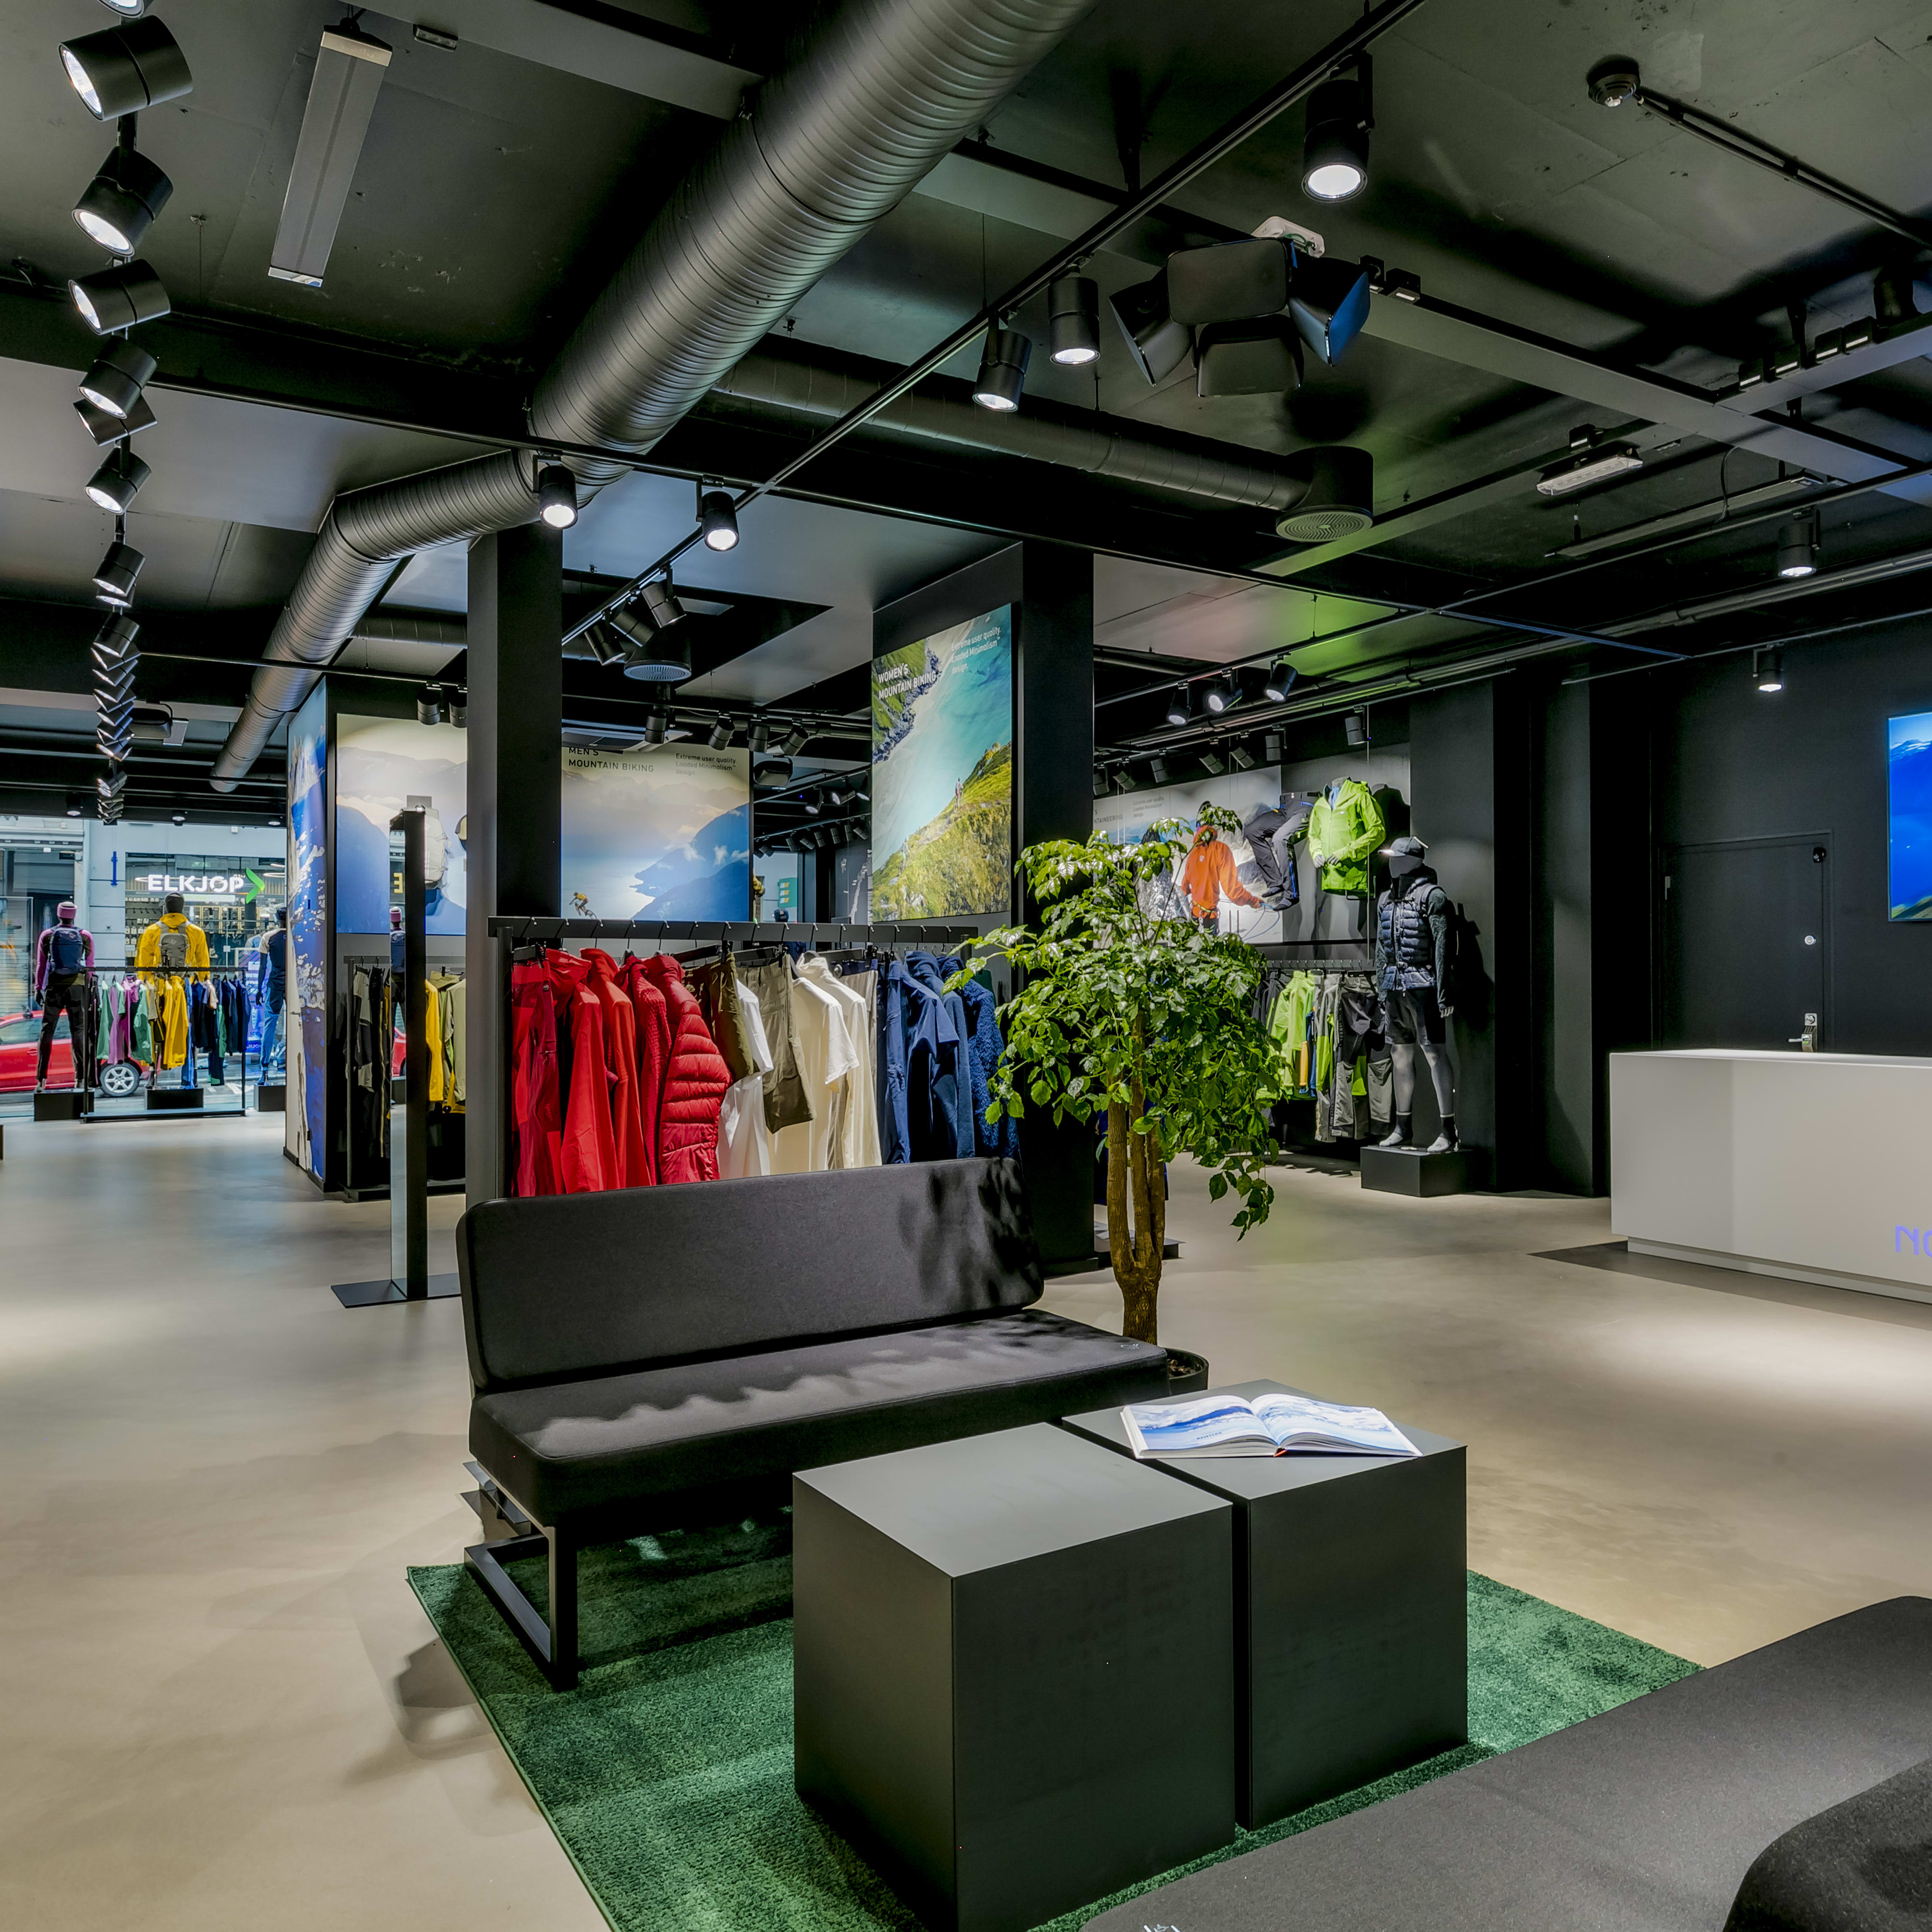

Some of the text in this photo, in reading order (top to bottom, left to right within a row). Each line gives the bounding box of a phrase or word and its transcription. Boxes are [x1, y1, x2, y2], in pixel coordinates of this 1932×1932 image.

[951, 626, 1001, 652] Extreme user quality.
[952, 649, 969, 663] Loaded
[878, 663, 908, 683] WOMEN'S
[879, 670, 936, 700] MOUNTAIN BIKING
[569, 747, 599, 756] MENS
[569, 759, 654, 772] MOUNTAIN BIKING
[1094, 814, 1123, 823] NTAINEERING
